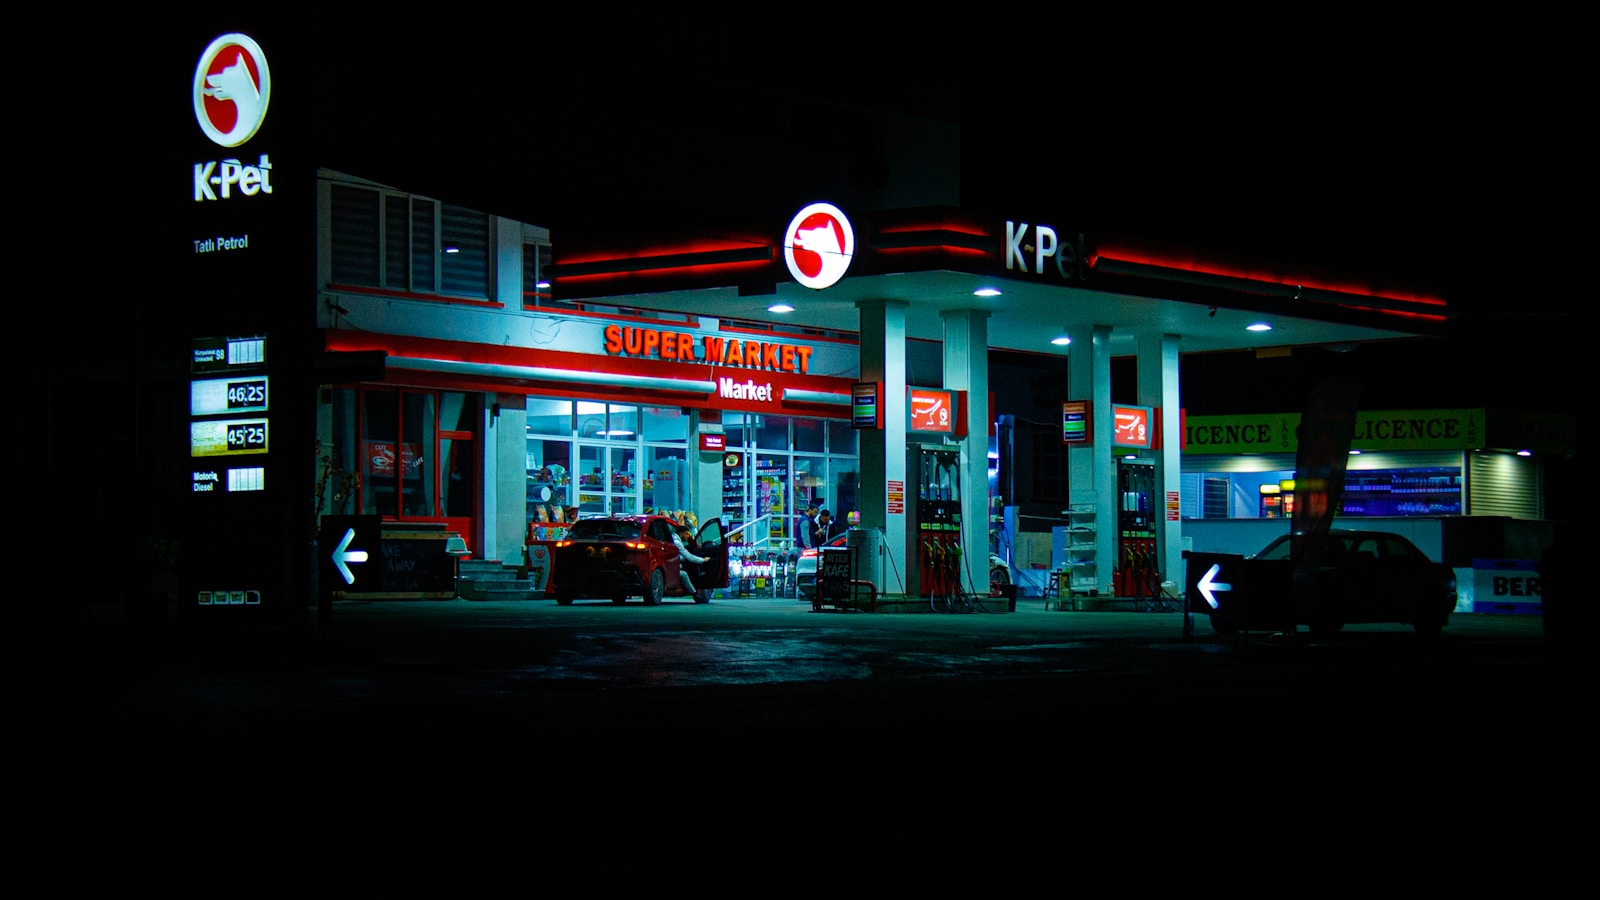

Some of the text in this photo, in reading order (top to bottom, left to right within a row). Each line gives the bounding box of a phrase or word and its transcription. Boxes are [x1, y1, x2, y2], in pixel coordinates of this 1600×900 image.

[193, 153, 273, 202] K-Pet
[216, 234, 249, 251] Petrol
[1005, 219, 1088, 281] K-Pet
[604, 324, 813, 374] SUPER MARKET
[719, 377, 773, 403] Market
[1186, 424, 1272, 444] ICENCE
[823, 563, 850, 578] KAFE
